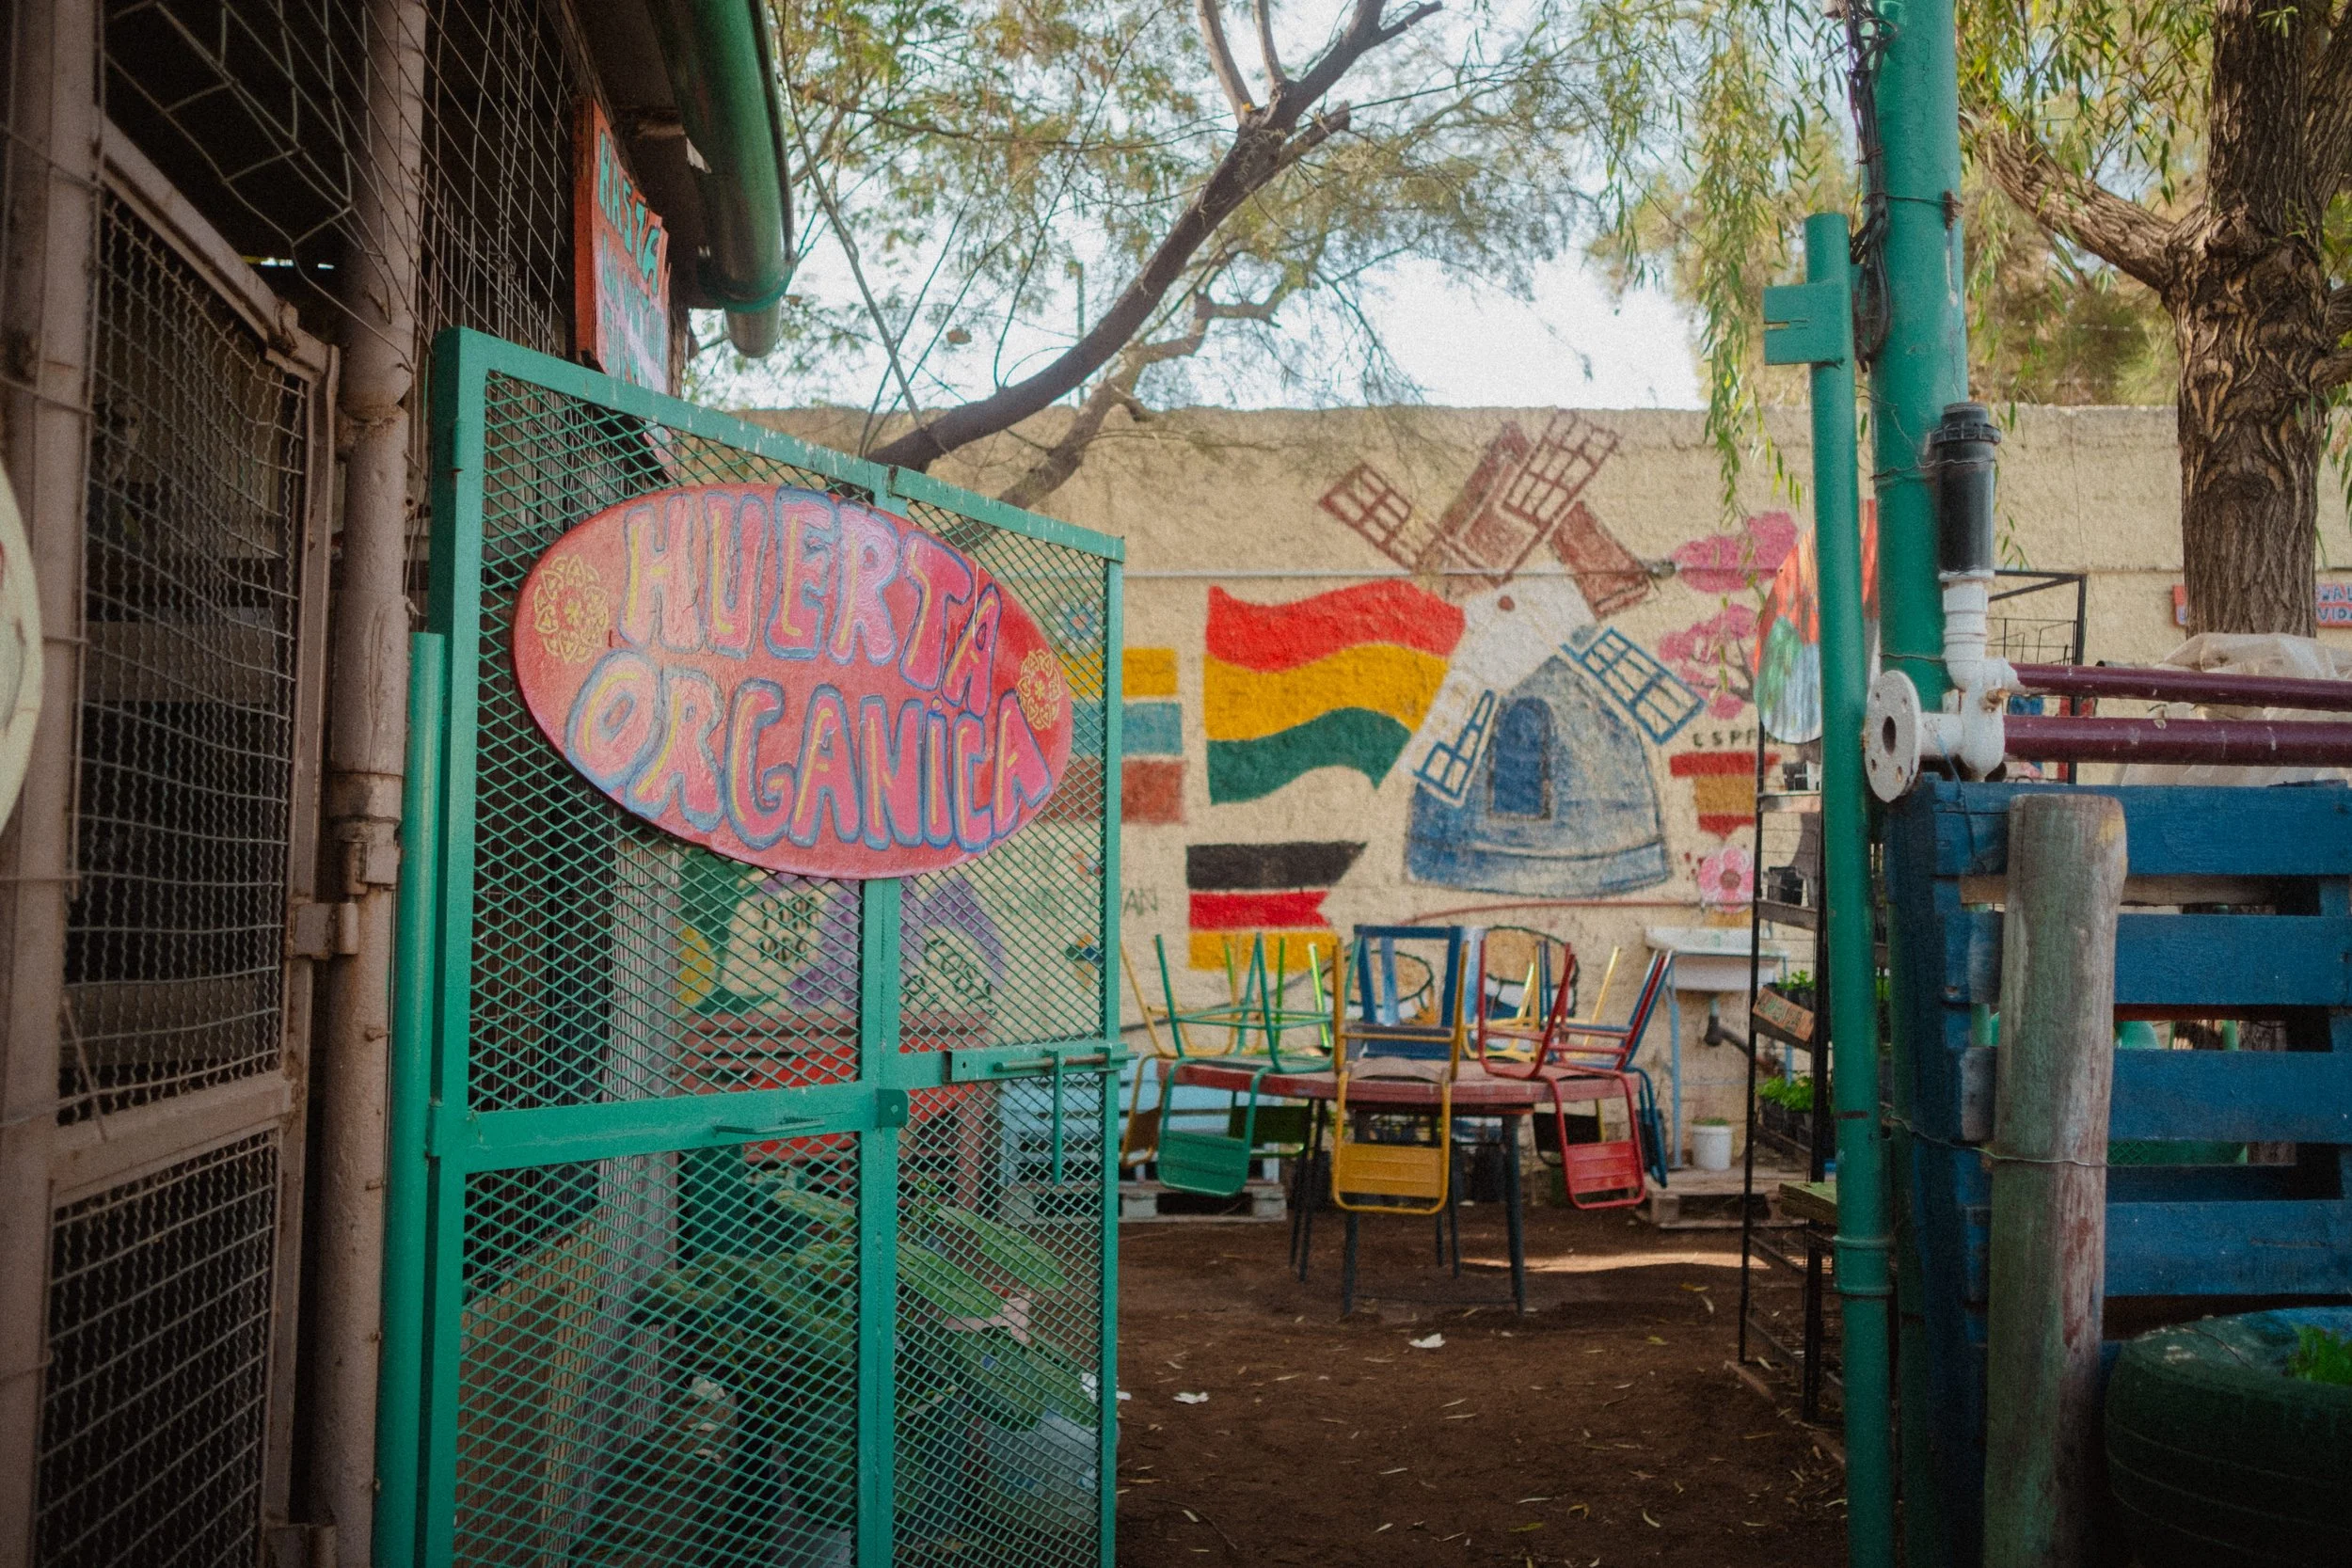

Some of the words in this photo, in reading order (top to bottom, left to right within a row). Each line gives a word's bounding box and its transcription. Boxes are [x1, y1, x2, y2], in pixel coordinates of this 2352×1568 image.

[597, 128, 660, 297] HASTA
[619, 486, 1002, 715] HUERTA
[2318, 608, 2352, 621] VID
